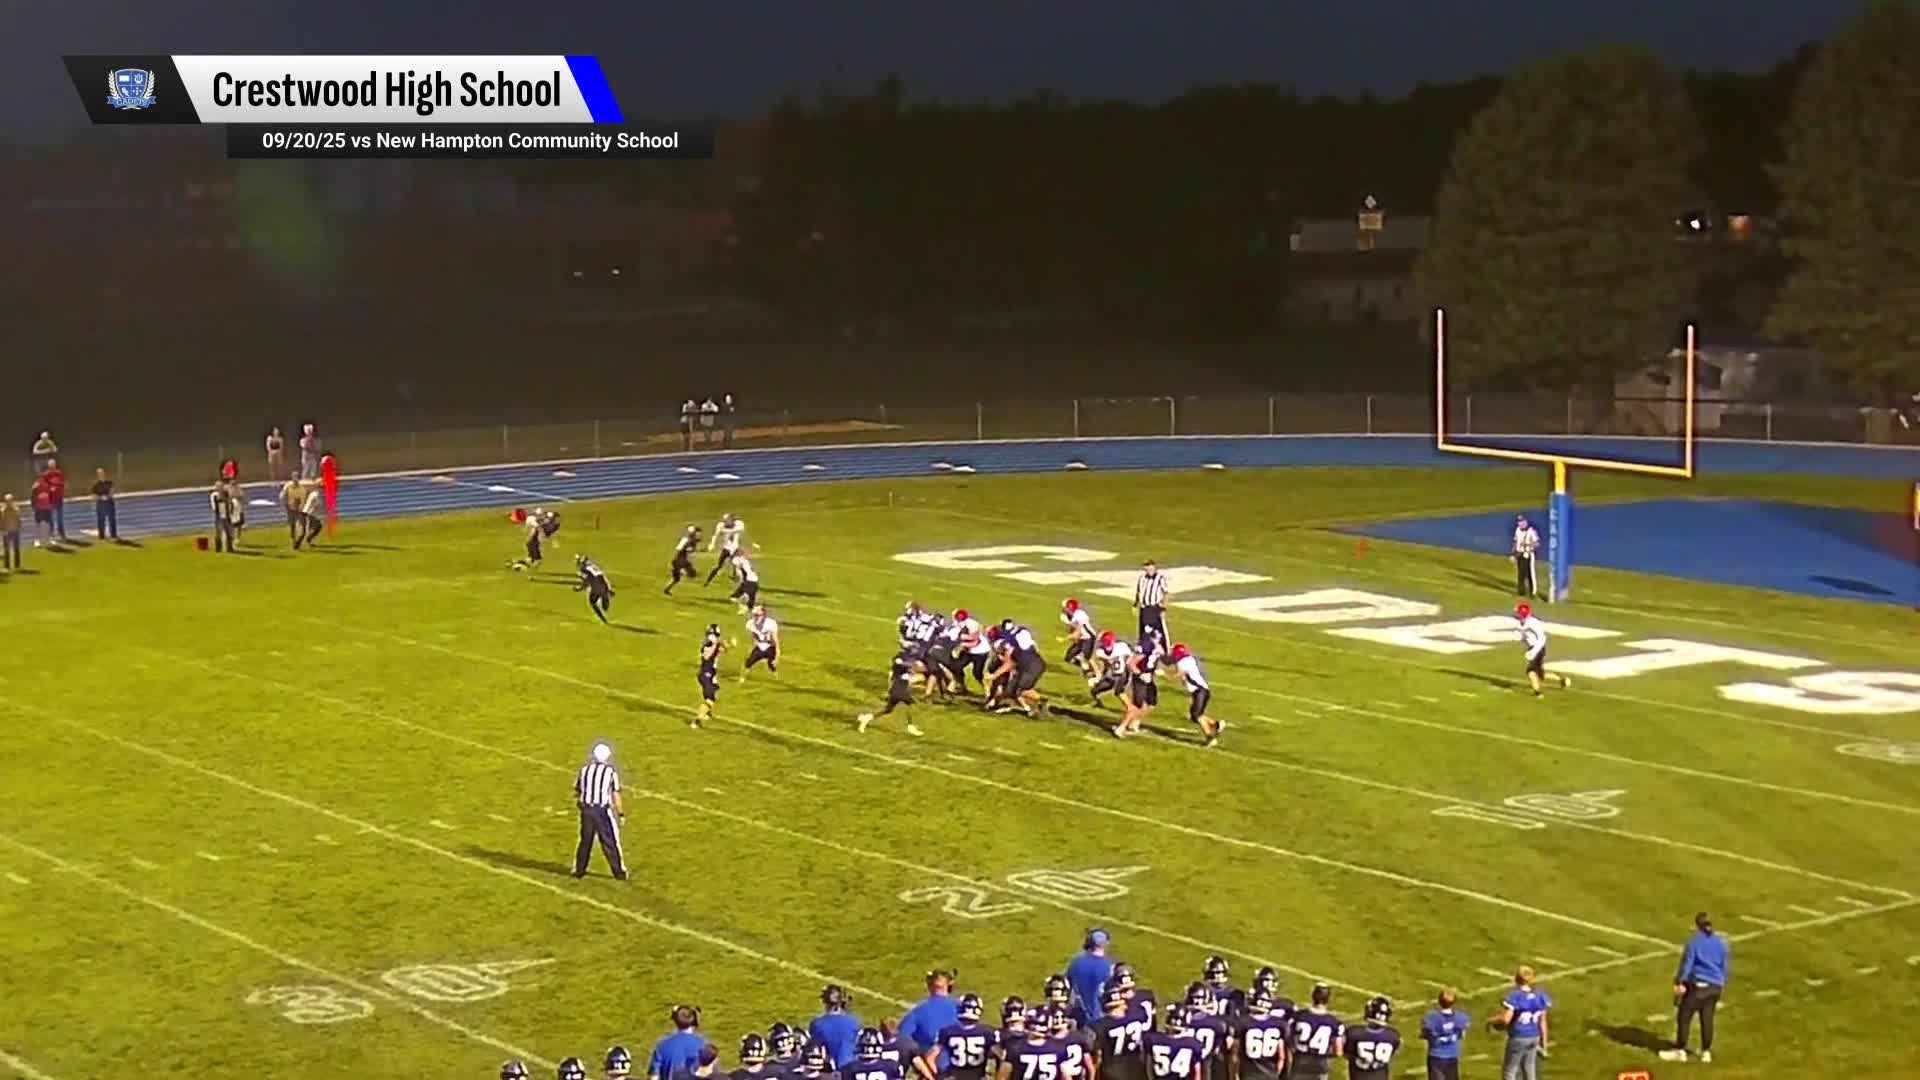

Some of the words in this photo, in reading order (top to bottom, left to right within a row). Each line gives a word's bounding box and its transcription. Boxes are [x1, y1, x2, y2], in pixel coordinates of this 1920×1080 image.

[891, 544, 1920, 715] CADETS
[899, 869, 1133, 919] 20
[244, 964, 508, 1023] 30
[949, 1036, 986, 1068] 35
[1245, 1027, 1280, 1059] 66
[1296, 1021, 1332, 1055] 24
[1019, 1053, 1057, 1080] 75
[1152, 1045, 1193, 1078] 54
[1355, 1041, 1393, 1070] 59
